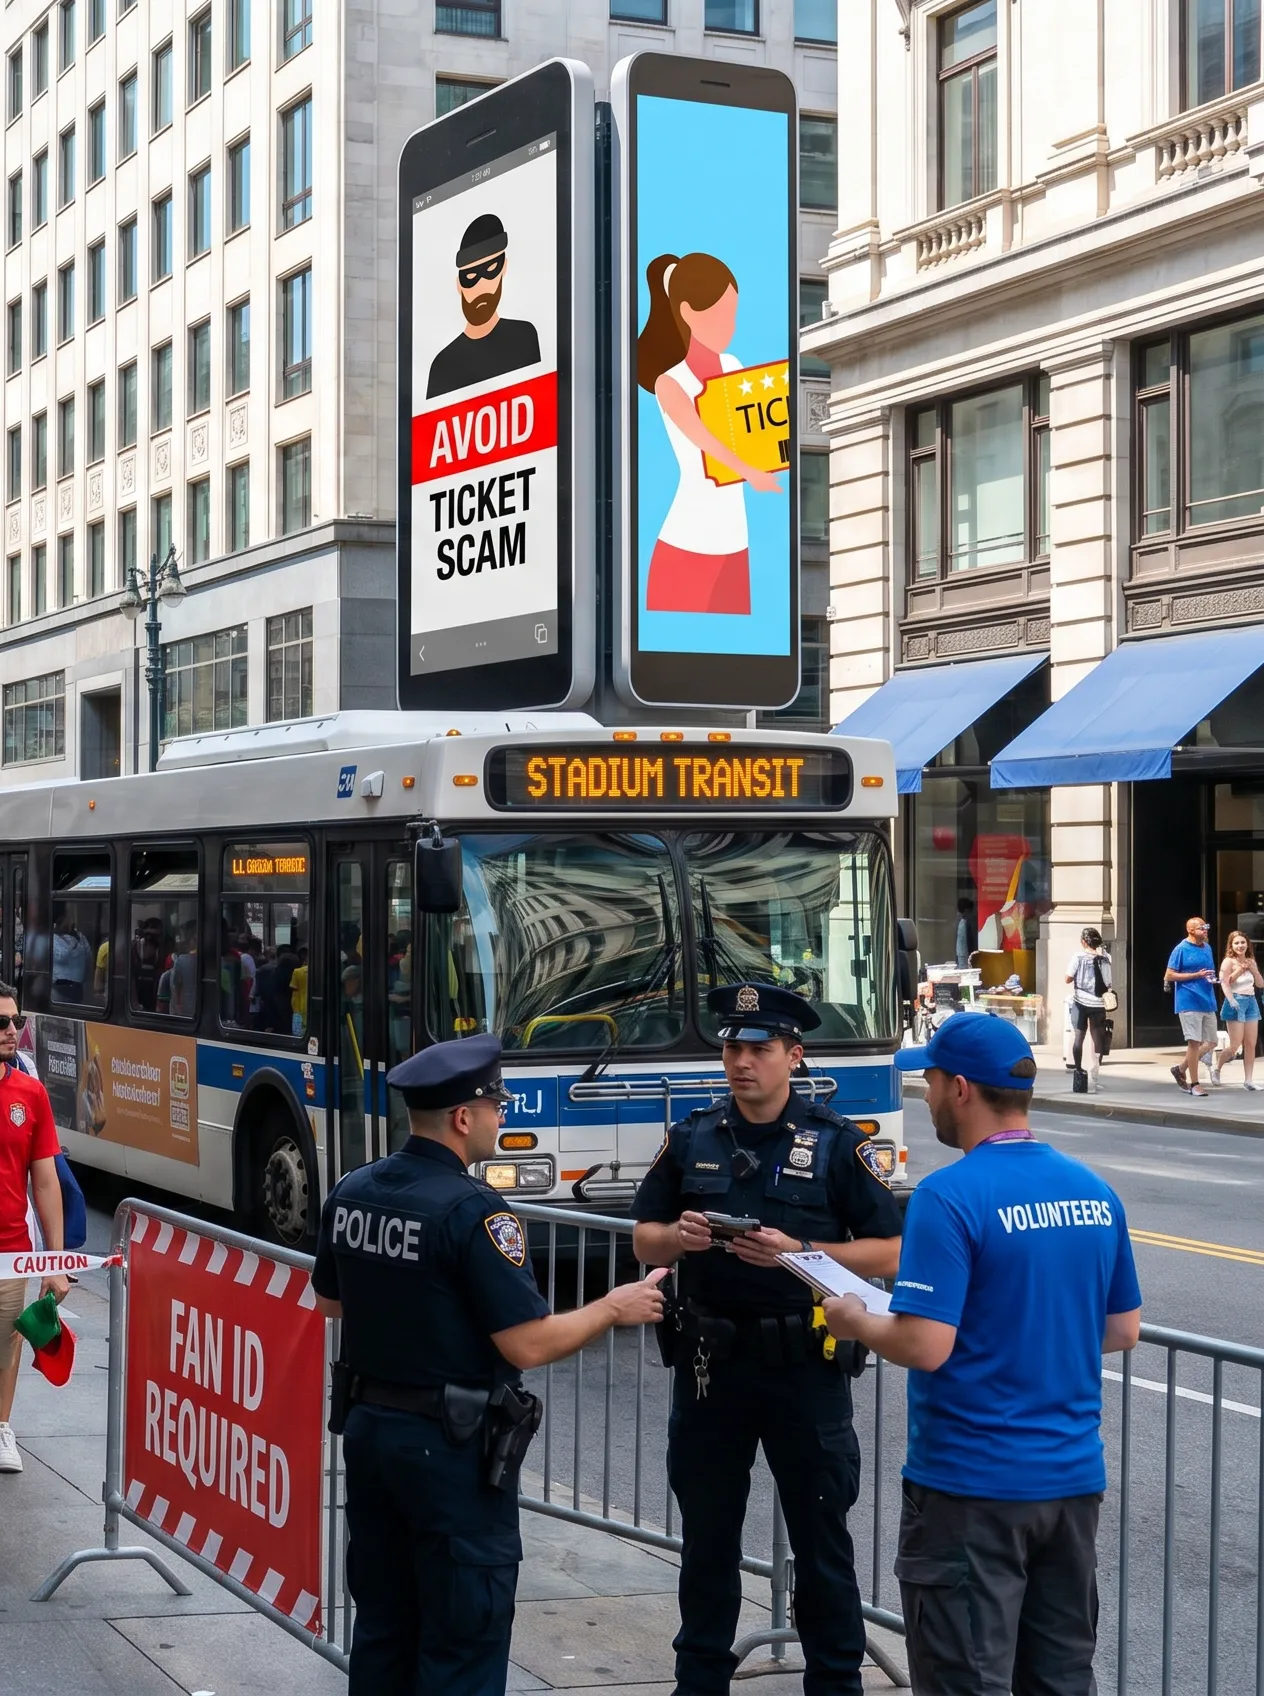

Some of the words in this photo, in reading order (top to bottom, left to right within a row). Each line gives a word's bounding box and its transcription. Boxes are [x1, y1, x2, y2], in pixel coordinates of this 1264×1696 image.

[429, 394, 535, 468] AVOID
[429, 467, 536, 533] TICKET
[436, 521, 526, 581] SCAM
[527, 757, 664, 797] STADIUM
[674, 758, 804, 797] TRANSIT
[332, 1206, 422, 1261] POLICE
[998, 1199, 1113, 1234] VOLUNTEERS
[13, 1255, 88, 1274] CAUTION
[169, 1298, 224, 1396] FAN
[232, 1324, 265, 1412] ID
[144, 1379, 291, 1529] REQUIRED
